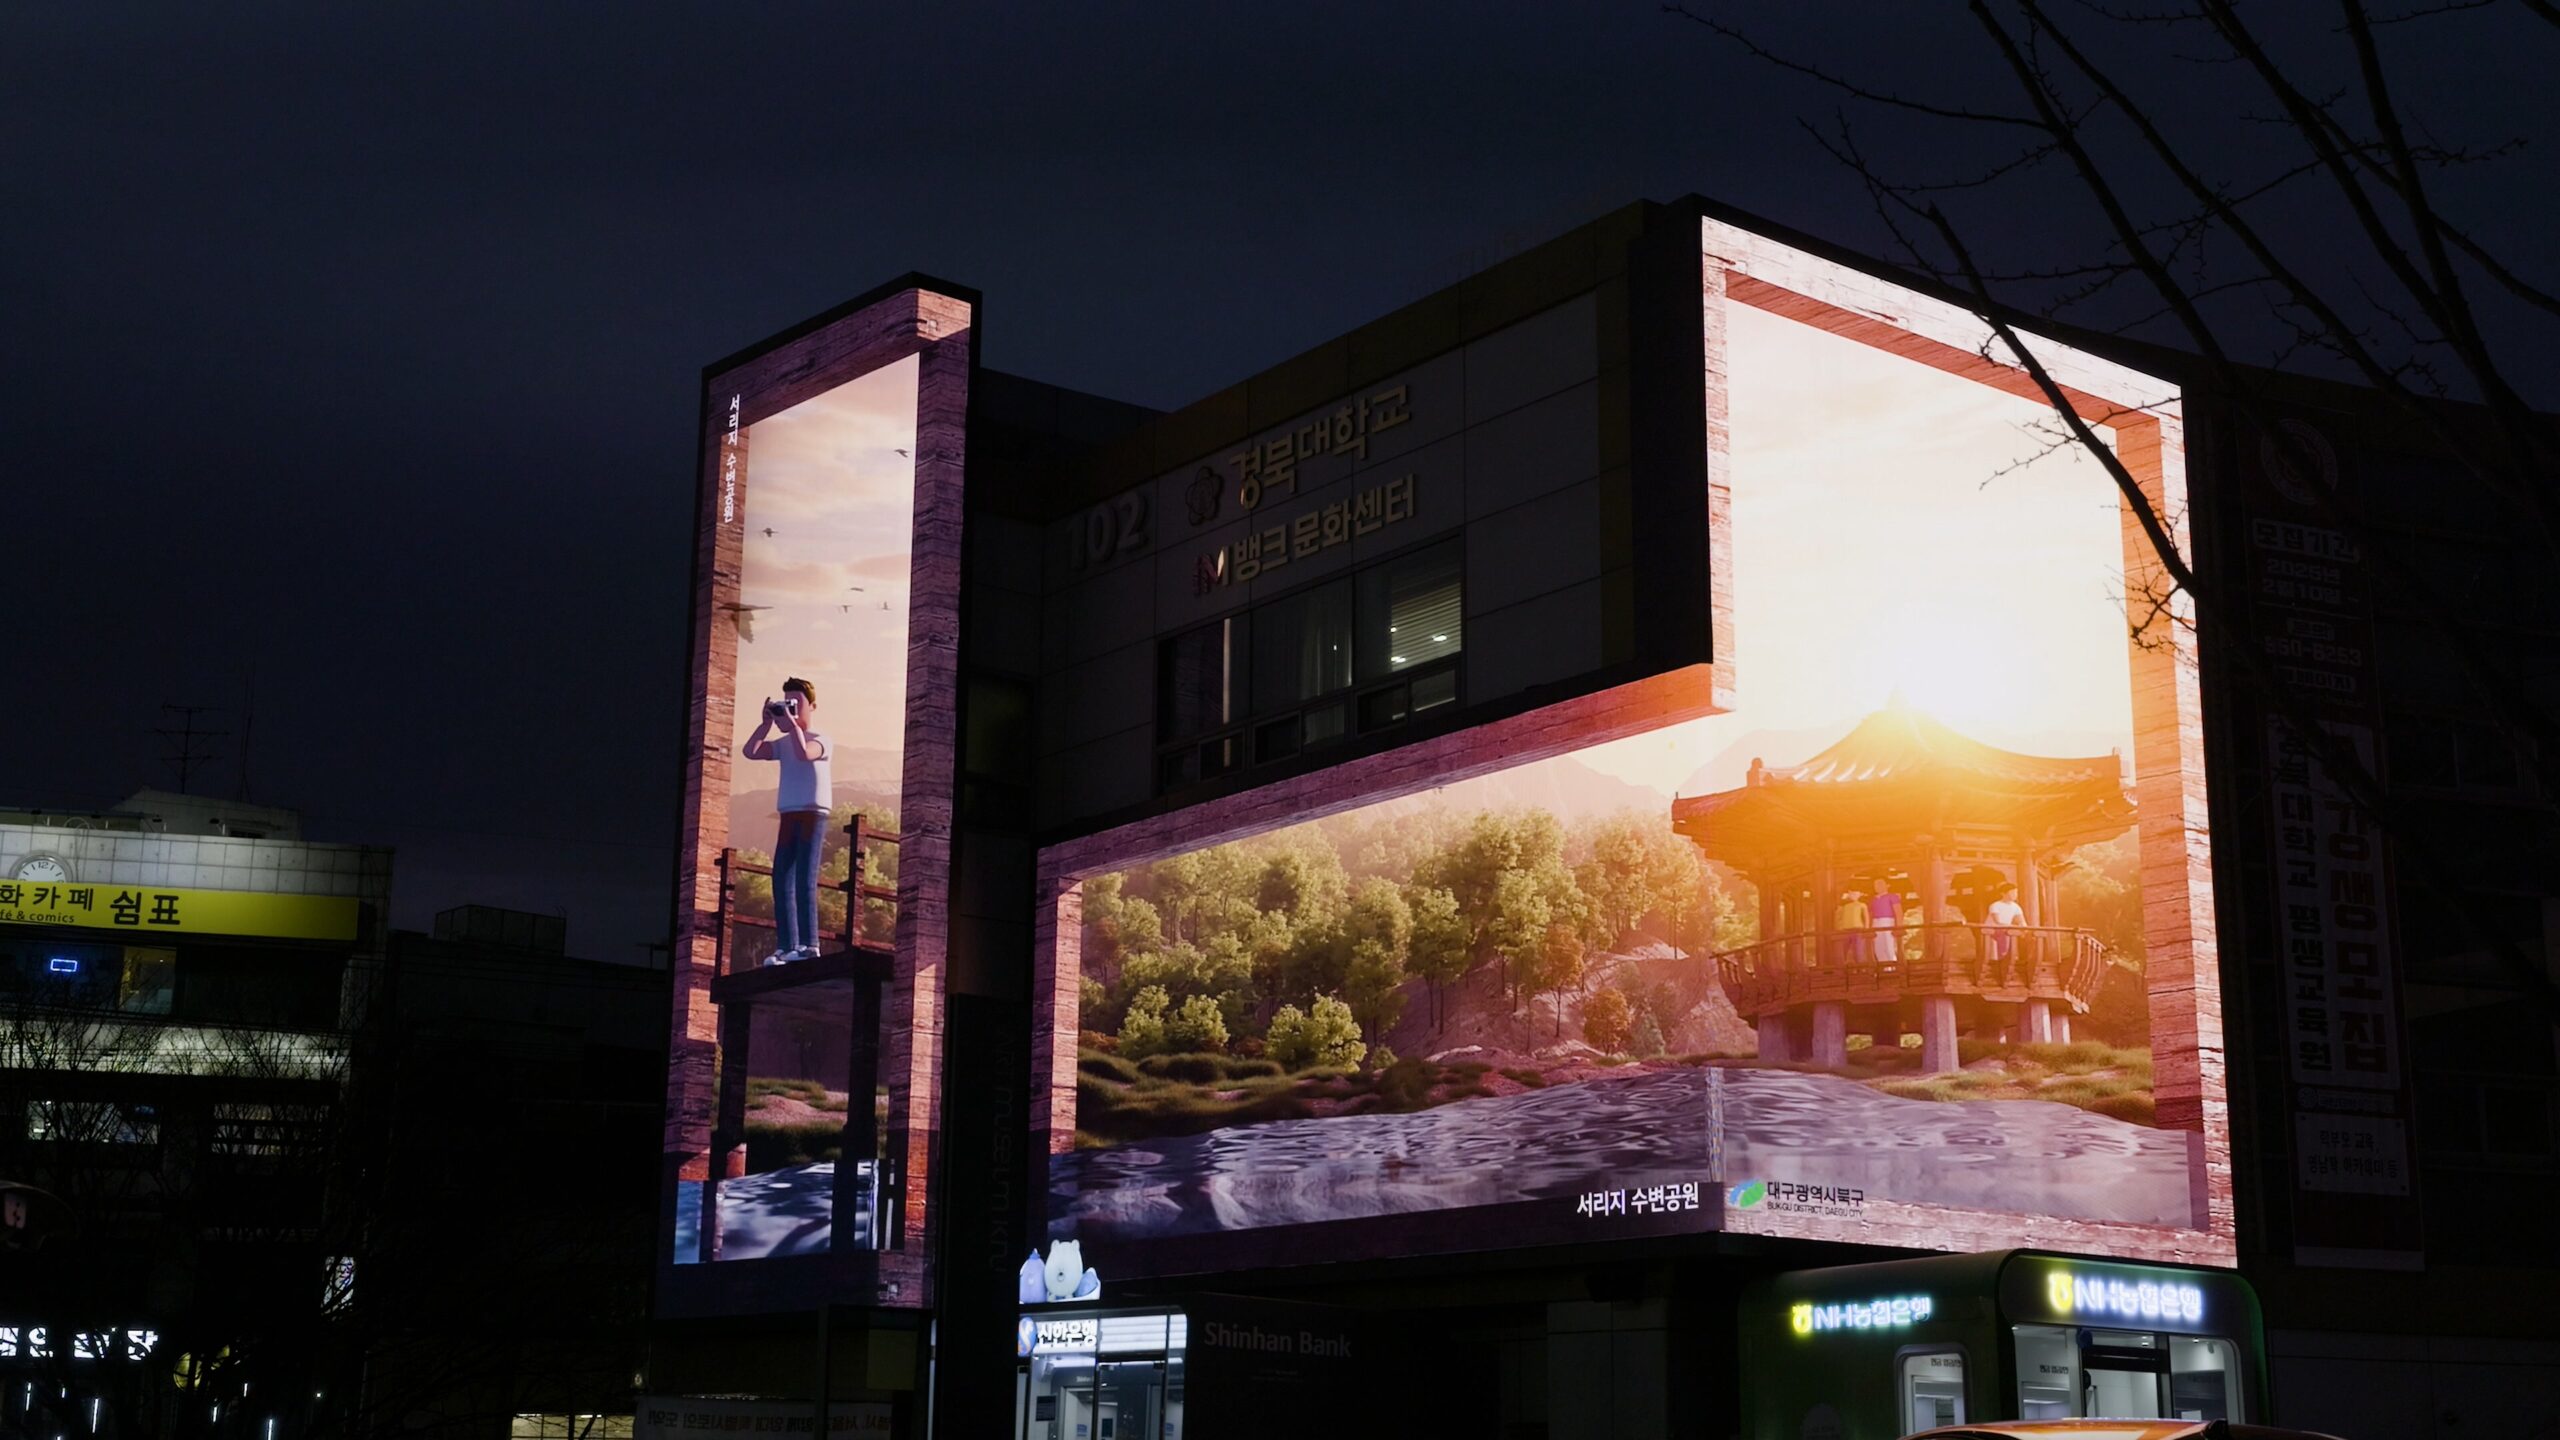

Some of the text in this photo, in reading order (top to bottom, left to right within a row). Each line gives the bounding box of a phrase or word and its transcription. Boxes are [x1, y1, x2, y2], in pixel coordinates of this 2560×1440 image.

[723, 394, 740, 524] 서리지 수변공원
[1229, 384, 1413, 511] 경북대학교
[1066, 490, 1149, 571] 102
[1294, 472, 1416, 560] 문화센터
[2257, 522, 2355, 561] 모집기간
[2266, 558, 2341, 585] 2025년
[16, 910, 25, 920] &
[29, 911, 75, 923] comics
[110, 890, 181, 926] 쉼표
[2323, 735, 2389, 1073] 강생모집
[2288, 903, 2333, 1071] 평생교육원
[1576, 1181, 1700, 1218] 서리지 수변공원
[1767, 1181, 1864, 1207] 대구광역시북구
[1825, 1206, 1848, 1217] DAEGU
[1849, 1208, 1864, 1218] CITY
[1813, 1297, 1932, 1330] NH농협은행
[2073, 1276, 2203, 1322] NH농협은행
[1037, 1320, 1098, 1347] 신한은행
[1204, 1321, 1353, 1358] Shinhan Bank
